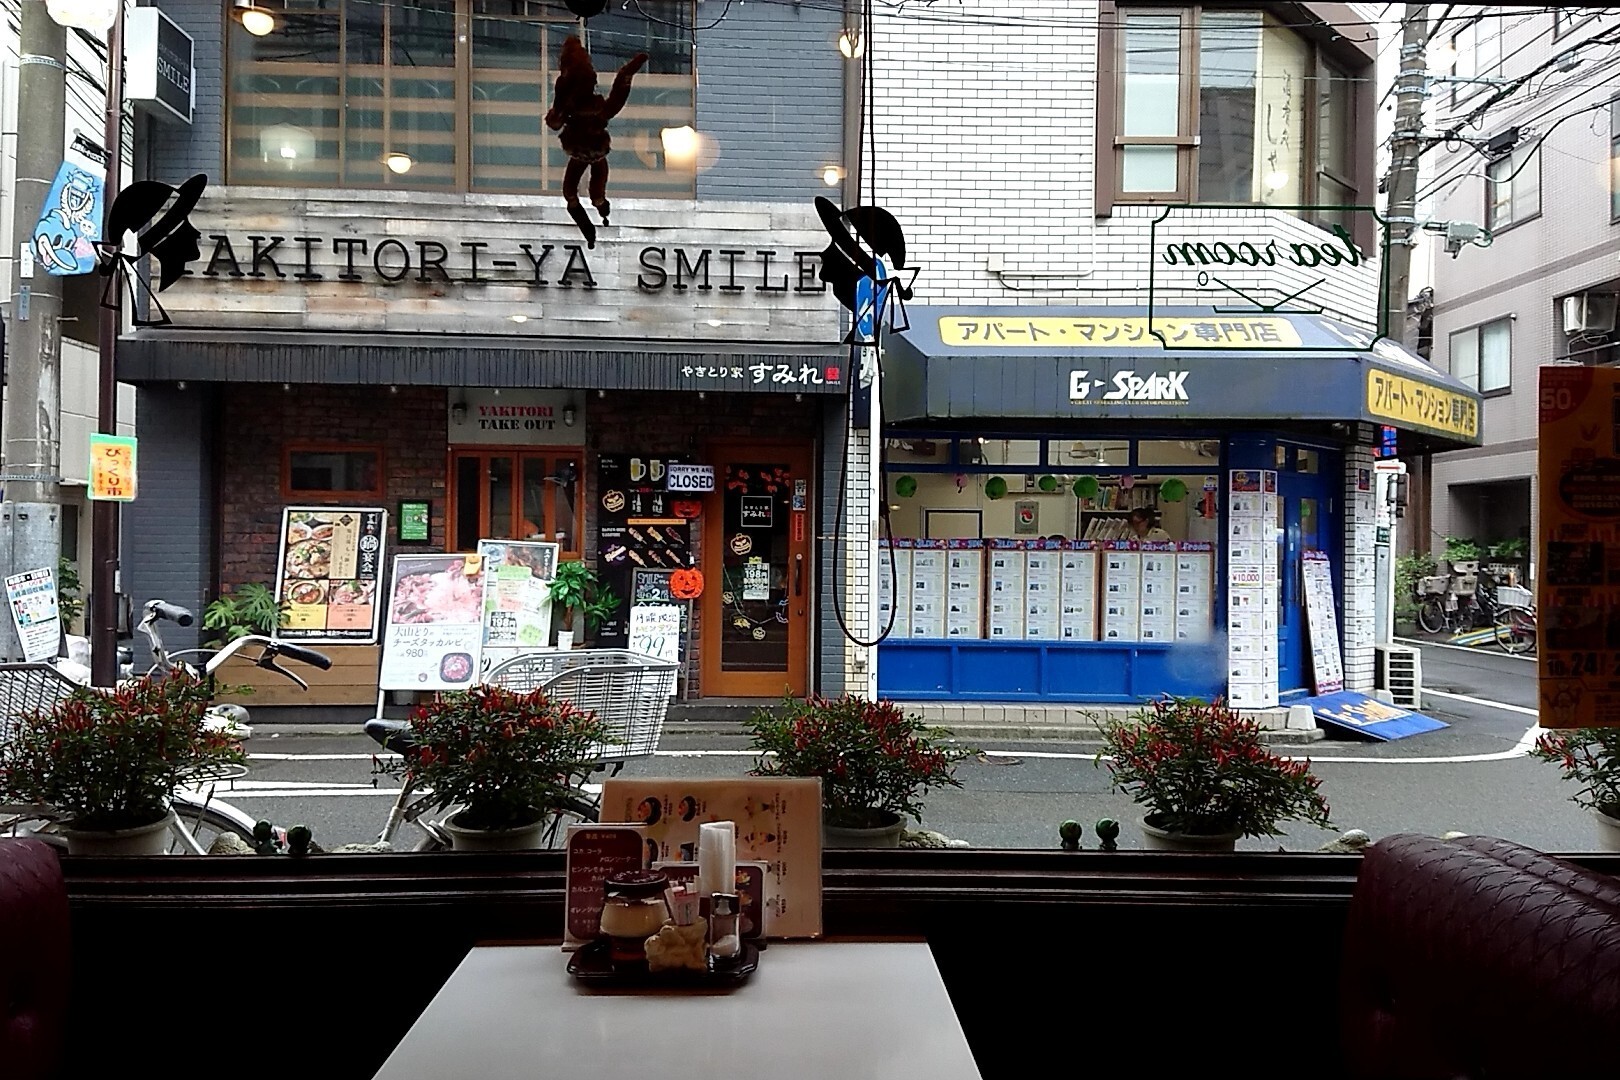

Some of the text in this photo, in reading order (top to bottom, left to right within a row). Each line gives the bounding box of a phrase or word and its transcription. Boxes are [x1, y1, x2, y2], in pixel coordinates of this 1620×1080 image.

[157, 56, 189, 94] SMILE
[184, 235, 826, 293] AKITORI-YA SMILE
[748, 362, 824, 385] すみれ
[479, 405, 554, 417] YAKITORI
[1375, 376, 1475, 433] アパート・マンション専門店
[478, 419, 556, 430] TAKE OUT
[105, 447, 123, 496] びっくり市
[669, 474, 714, 489] CLOSED
[392, 638, 464, 648] チーズタッカルビ
